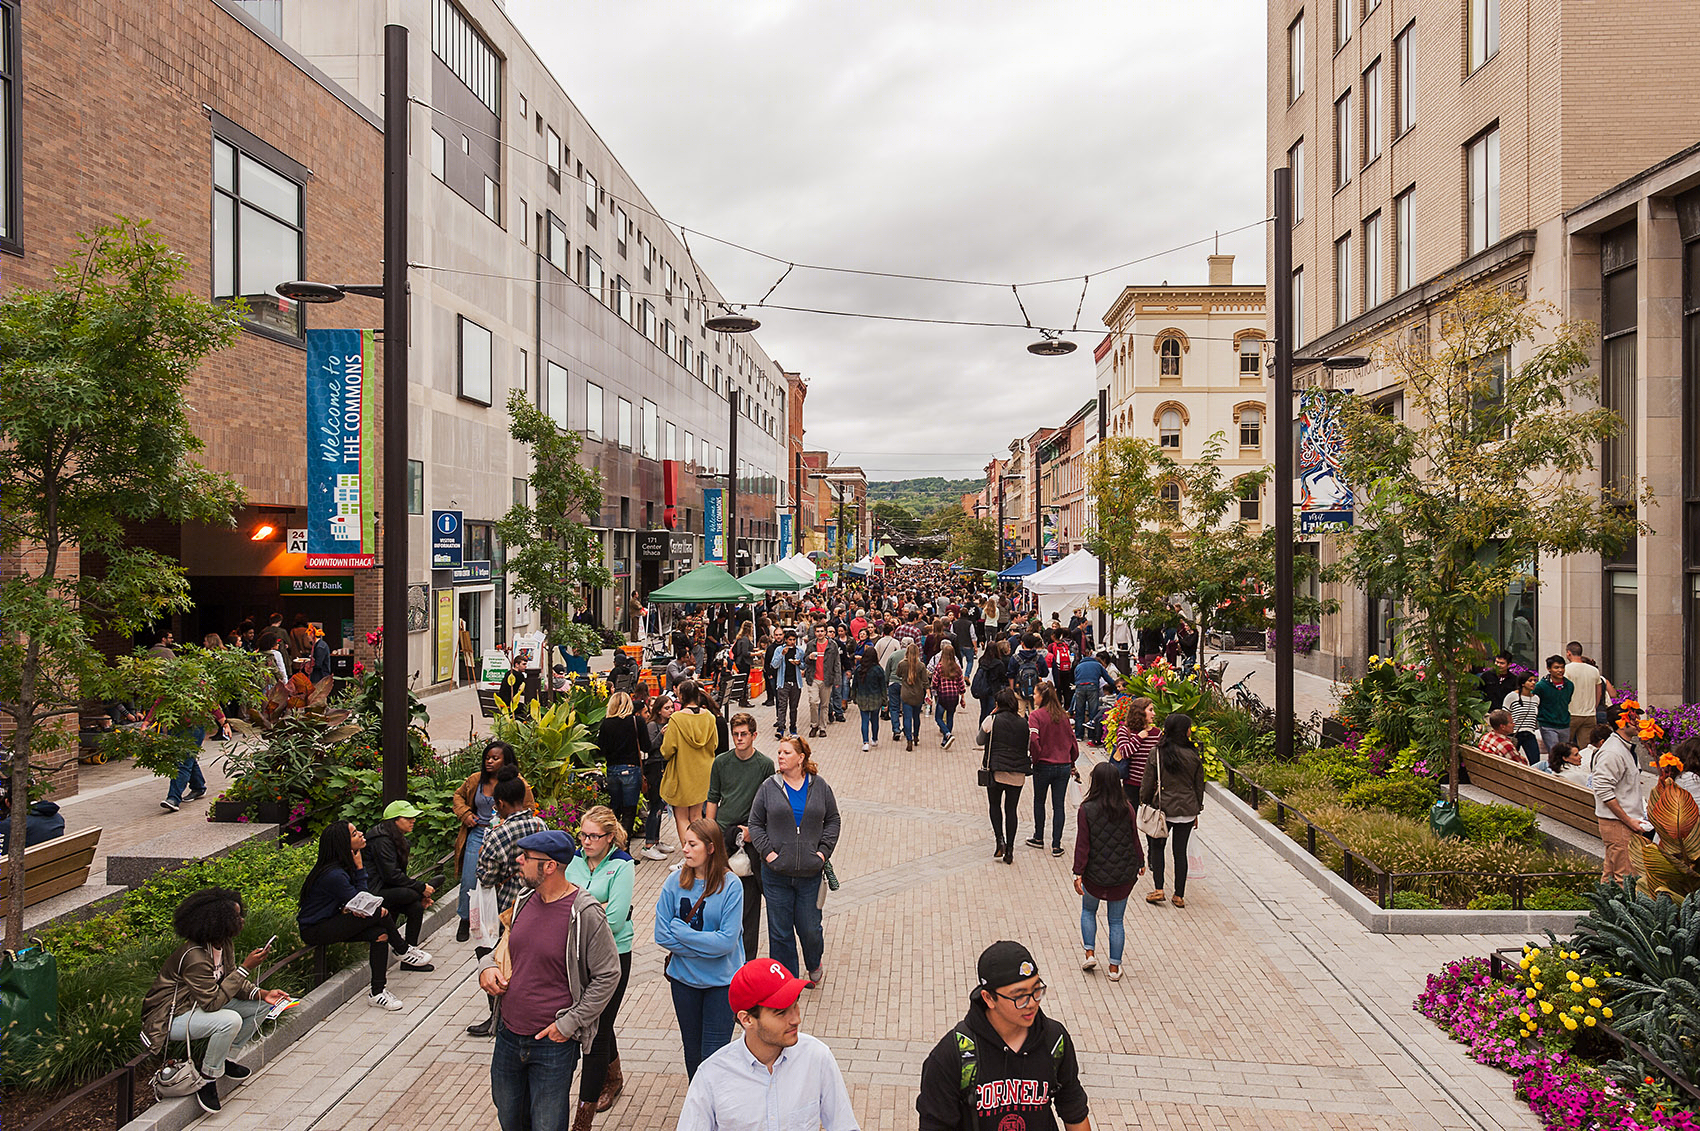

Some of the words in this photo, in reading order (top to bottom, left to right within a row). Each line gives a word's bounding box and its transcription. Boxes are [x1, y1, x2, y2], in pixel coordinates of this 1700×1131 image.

[322, 355, 341, 375] to
[344, 354, 362, 431] COMMONS
[320, 379, 341, 462] Welcome
[344, 435, 360, 464] THE
[292, 531, 304, 539] 24
[290, 540, 307, 551] AT
[309, 558, 348, 567] DOWNTOWN
[348, 557, 372, 567] ITHACA
[322, 581, 343, 589] Bank
[770, 963, 785, 980] P
[976, 1078, 1050, 1110] CORNELL
